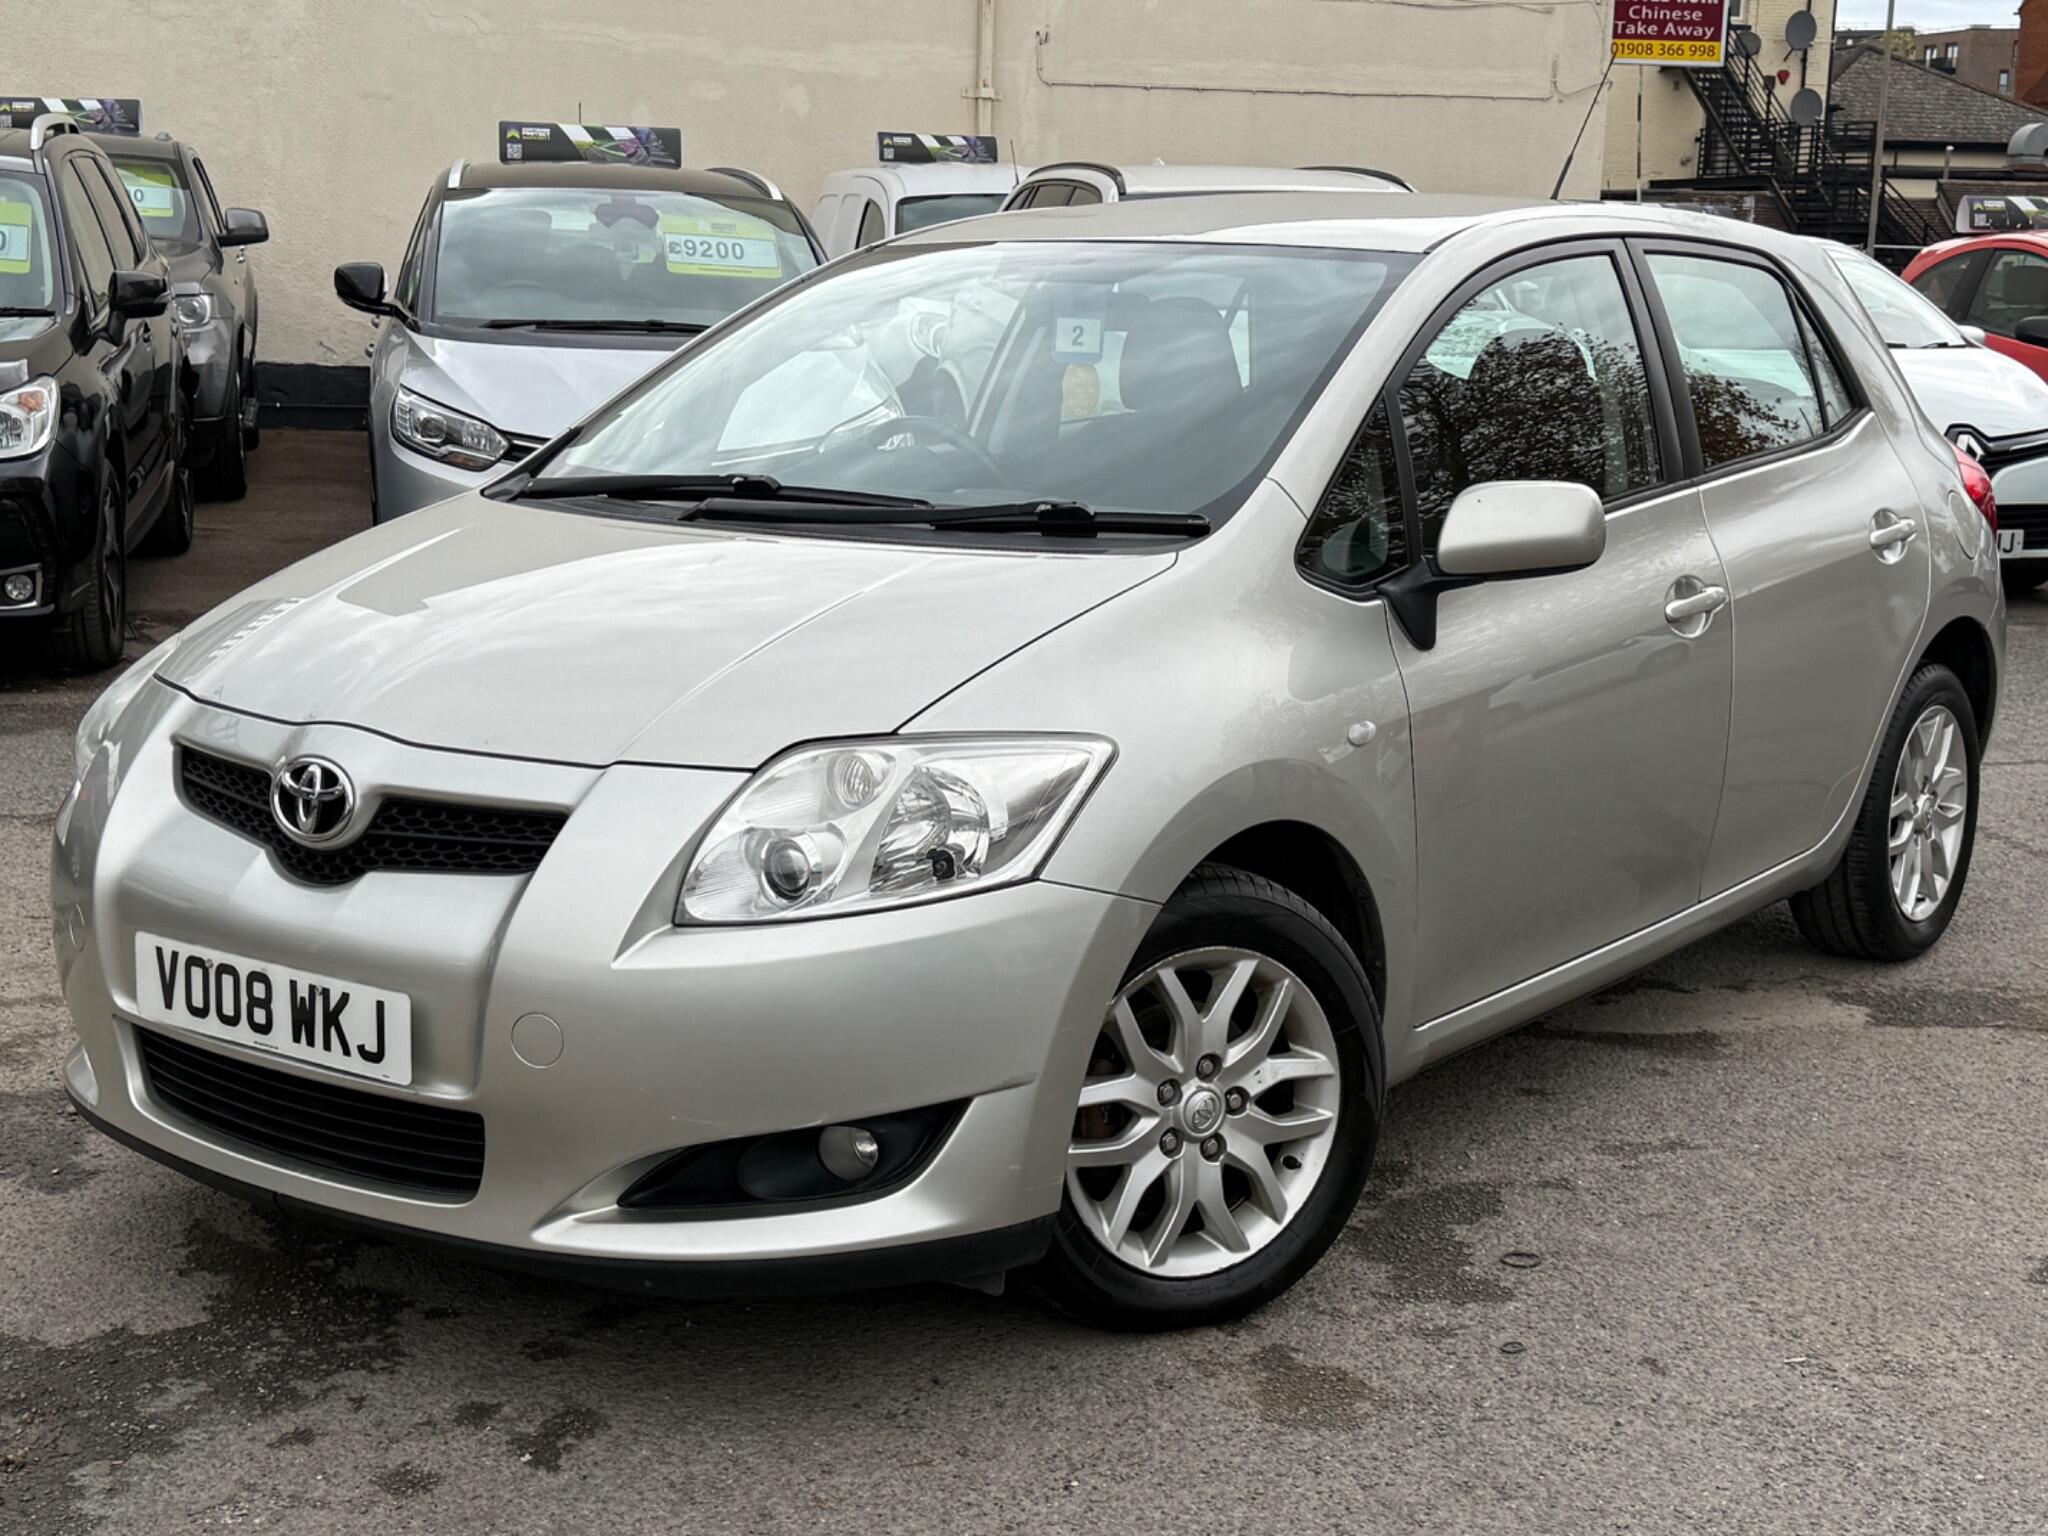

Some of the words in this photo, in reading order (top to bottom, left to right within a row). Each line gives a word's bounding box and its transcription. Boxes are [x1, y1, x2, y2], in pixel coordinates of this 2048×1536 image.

[1628, 5, 1703, 21] Chinese
[1614, 21, 1659, 35] Take
[1663, 22, 1715, 40] Away
[1611, 42, 1653, 56] 01908
[1658, 44, 1685, 57] 366
[1688, 44, 1716, 58] 998
[1071, 325, 1085, 347] 2
[155, 945, 274, 1036] VO08
[289, 979, 386, 1064] WKJ
